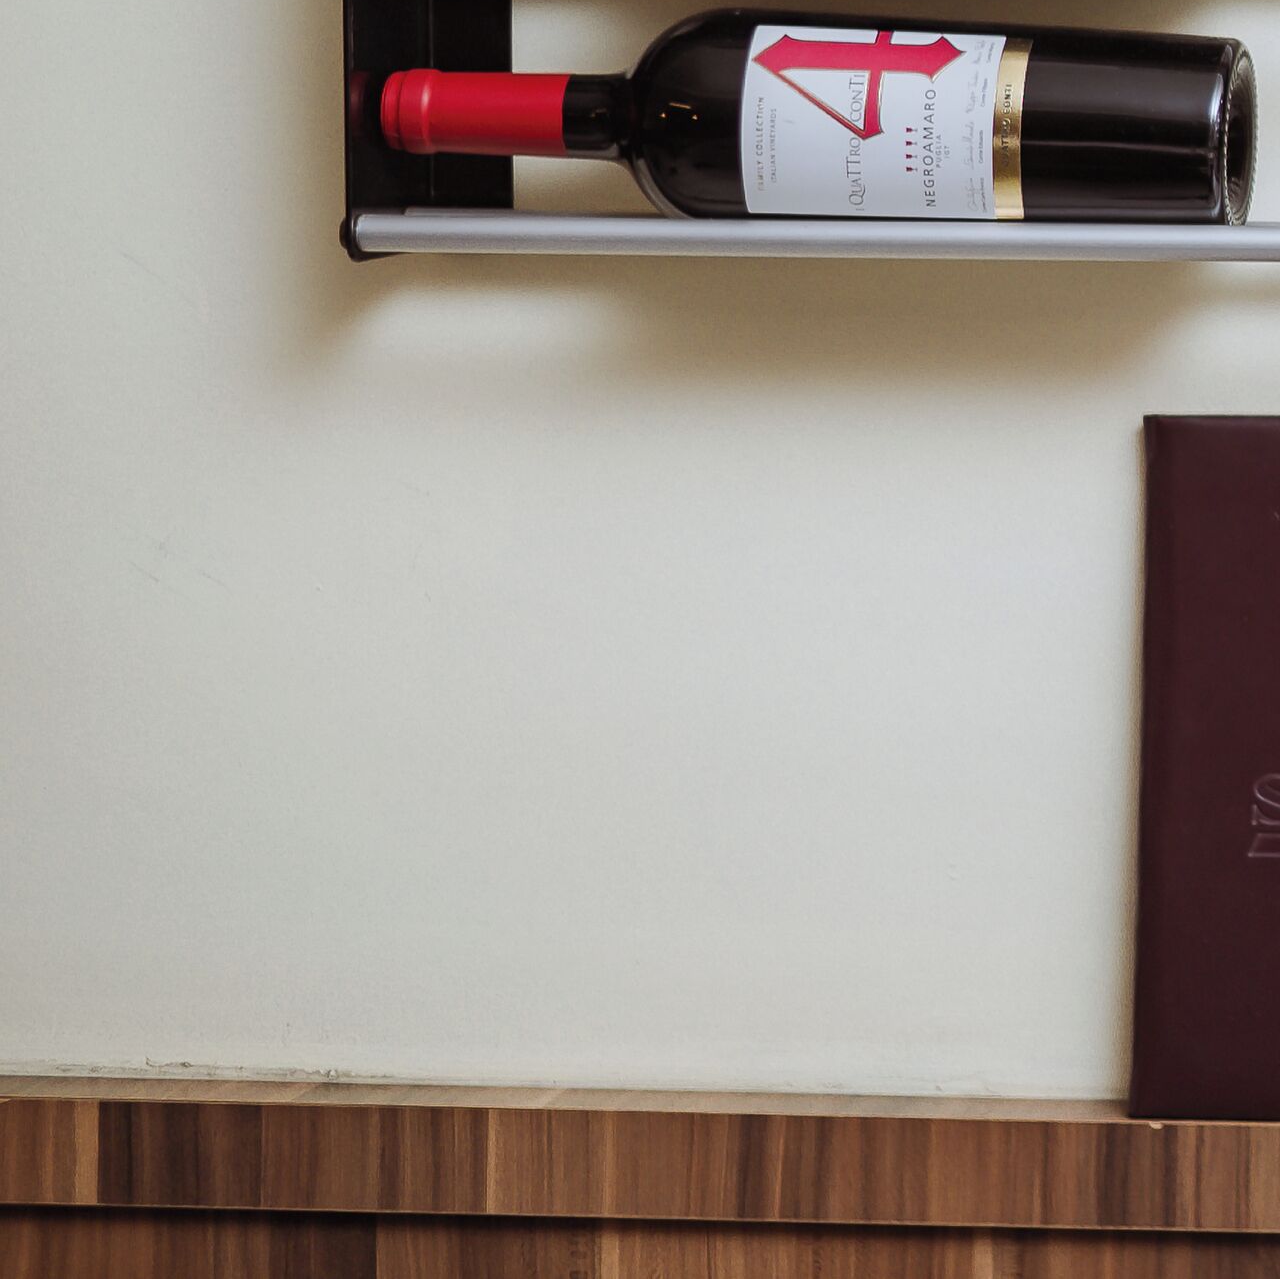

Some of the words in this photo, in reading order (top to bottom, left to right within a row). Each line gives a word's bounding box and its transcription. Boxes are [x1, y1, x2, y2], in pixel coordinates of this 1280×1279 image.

[1002, 82, 1012, 114] CONTI
[756, 96, 766, 158] COLLECTION
[769, 107, 778, 152] VINEYARDS
[922, 88, 938, 208] NEGROAMARO
[1000, 117, 1012, 168] QUATTRO
[770, 153, 778, 184] ITALIAN
[934, 133, 942, 169] PUGLIA
